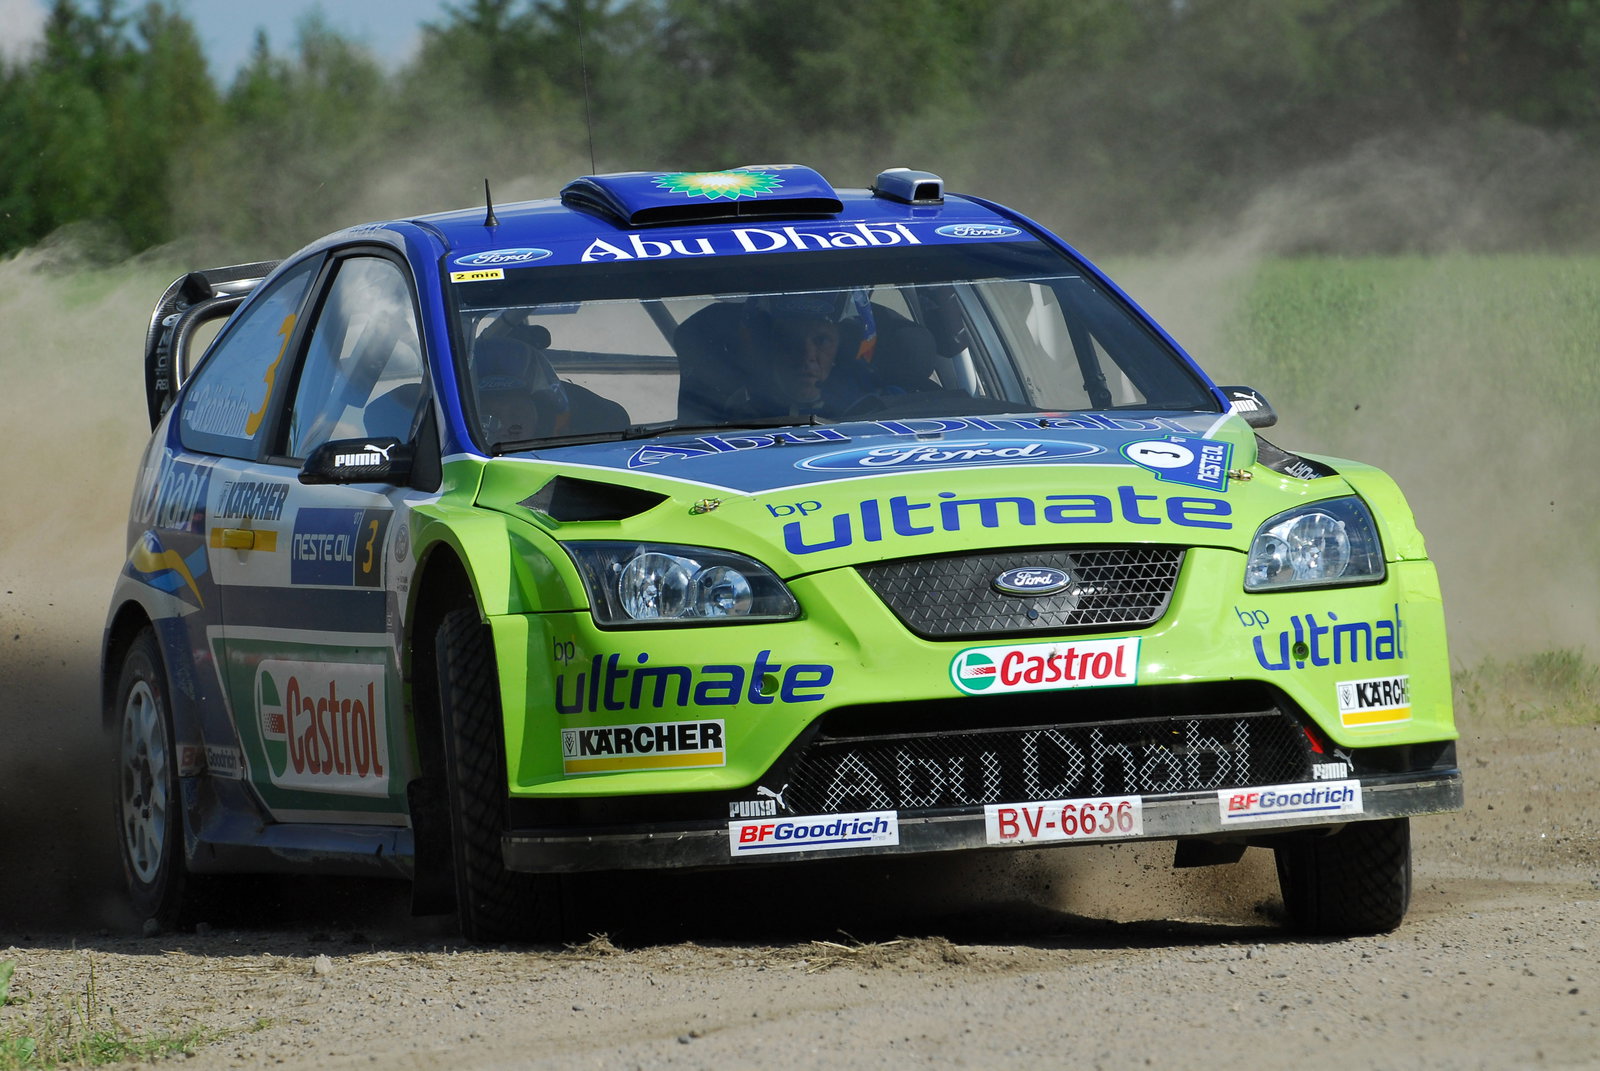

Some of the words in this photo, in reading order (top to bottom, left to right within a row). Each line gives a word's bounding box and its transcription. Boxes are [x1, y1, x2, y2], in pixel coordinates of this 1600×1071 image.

[580, 234, 717, 263] Abu
[731, 222, 923, 254] Dhabi
[950, 224, 1006, 237] Ford
[473, 250, 533, 264] Ford
[471, 271, 499, 279] min
[245, 313, 297, 437] 3
[627, 428, 852, 469] Abu
[874, 413, 1198, 436] Dhabi
[858, 442, 1049, 466] Ford
[1140, 448, 1181, 459] 3
[334, 452, 381, 467] PUMA
[1197, 453, 1223, 484] NESTE
[1284, 461, 1325, 481] PORT
[222, 481, 290, 521] KÄRCHER
[766, 500, 822, 518] bp
[782, 485, 1233, 556] ultimate
[293, 533, 333, 561] NESTE
[334, 534, 353, 562] OIL
[362, 519, 379, 574] 3
[1013, 571, 1053, 586] Ford
[1234, 605, 1270, 630] bp
[552, 635, 575, 667] bp
[1252, 602, 1405, 671] ultimat
[1000, 644, 1127, 686] Castrol
[555, 649, 834, 715] ultimate
[286, 676, 383, 778] Castrol
[578, 722, 723, 756] KÄRCHER
[822, 749, 1000, 812] Abu
[1020, 718, 1251, 801] Dhabi
[1312, 762, 1348, 780] PUMA
[729, 799, 777, 818] PUMA
[1228, 786, 1355, 812] BFGoodrich
[739, 816, 889, 844] BFGoodrich
[997, 799, 1135, 840] BV-6636
